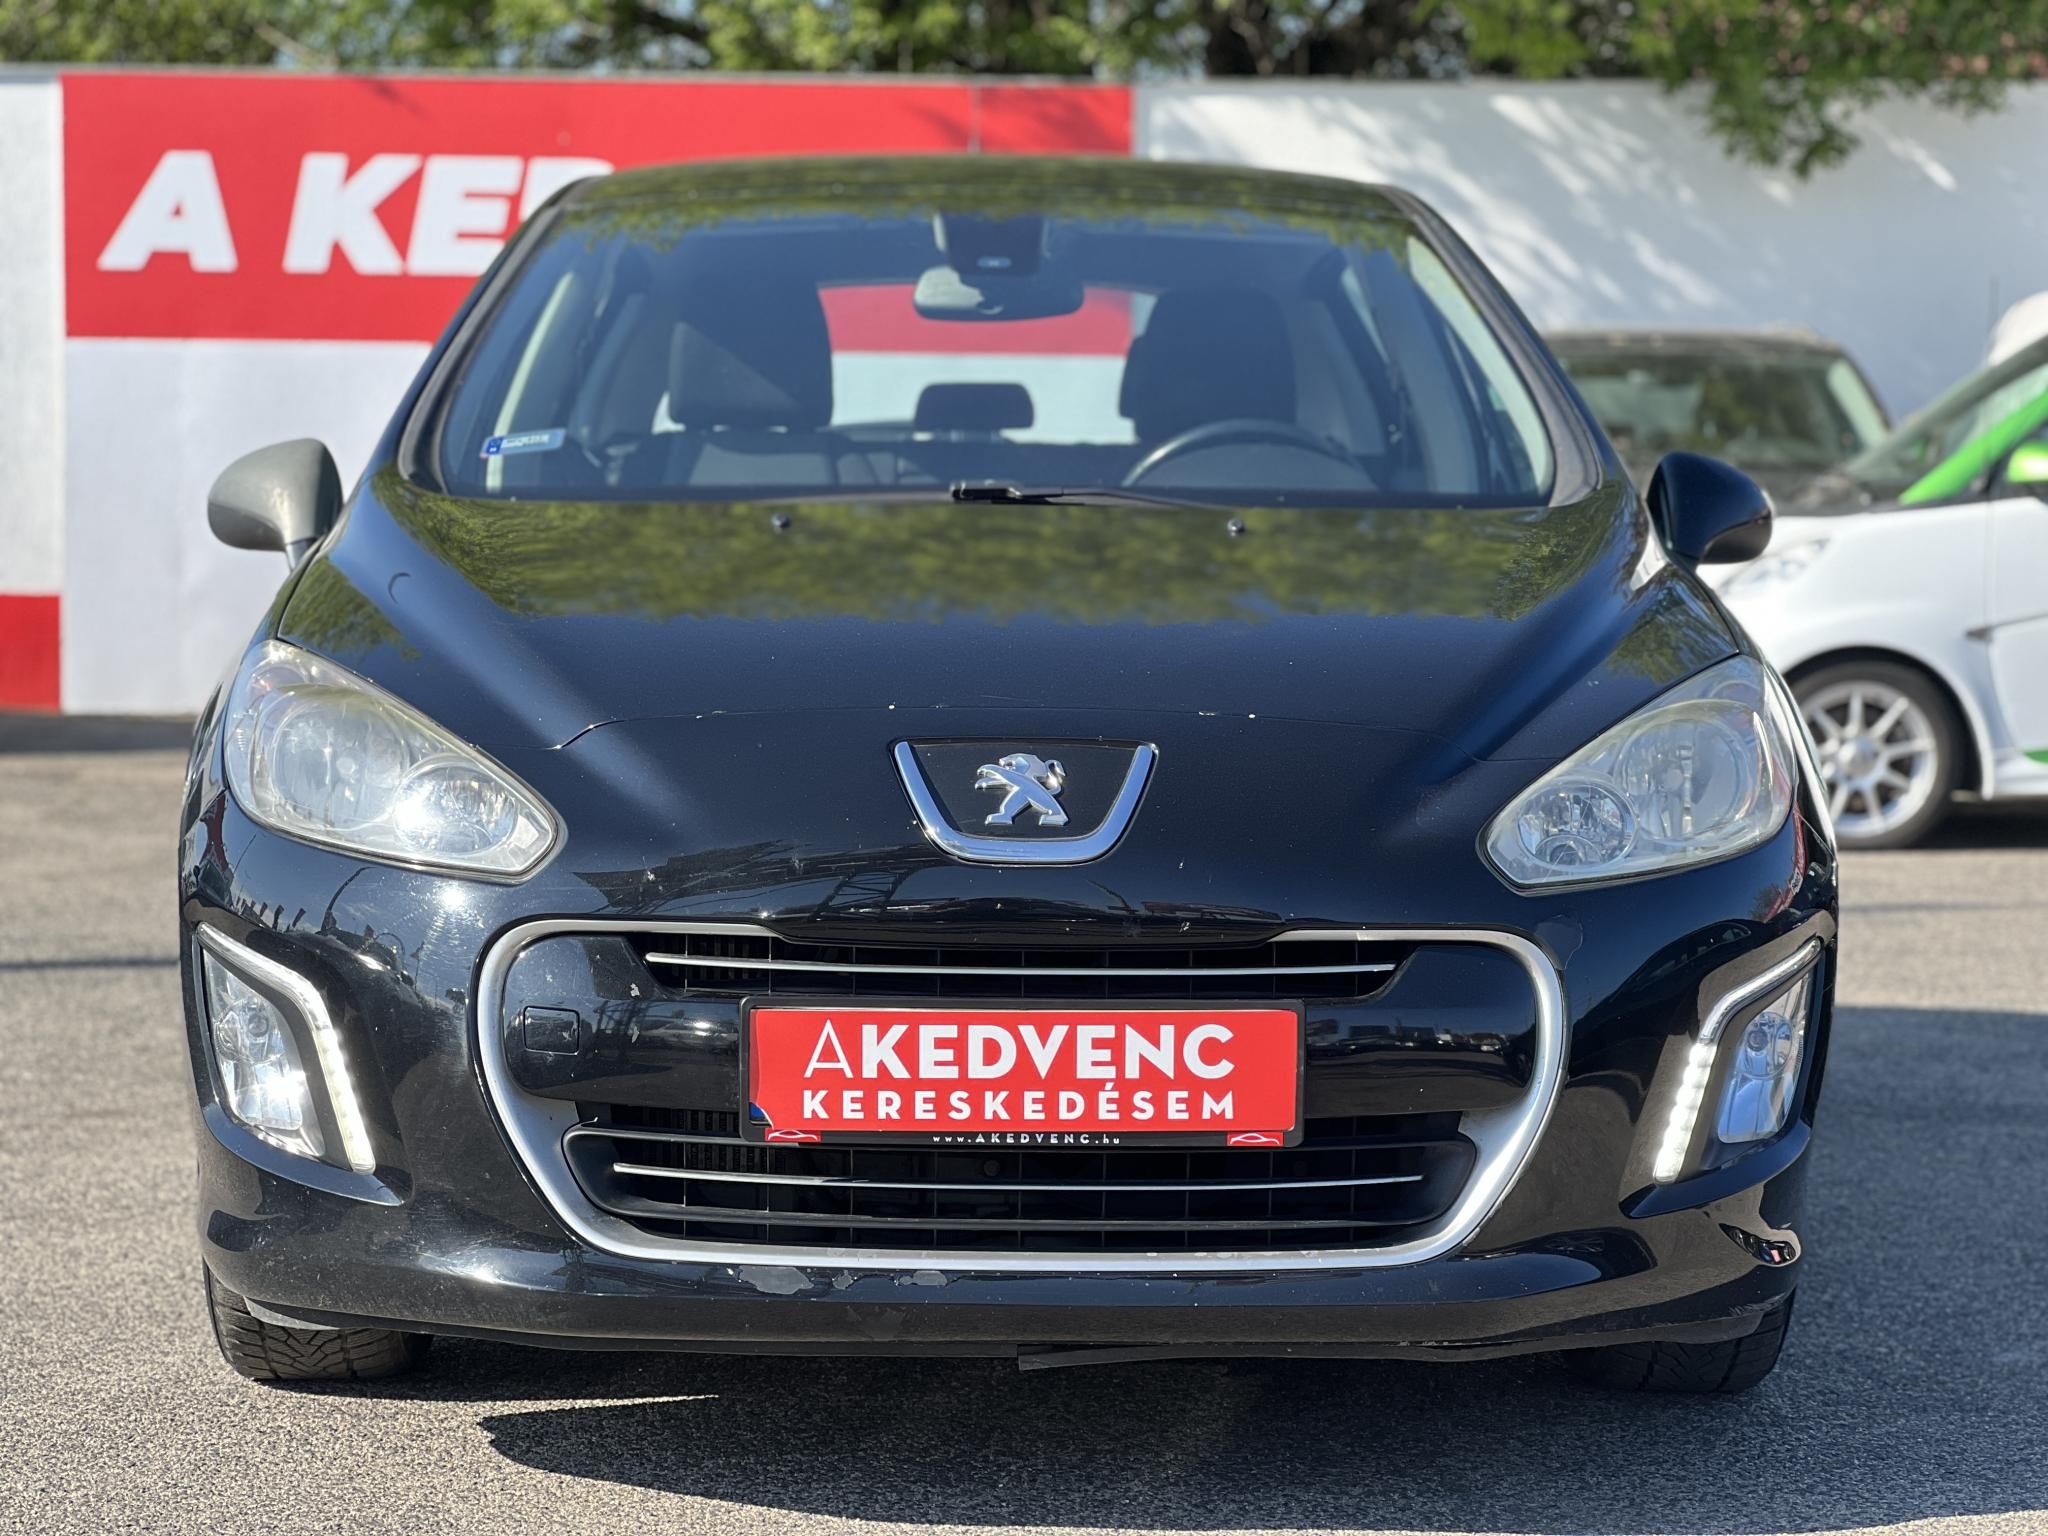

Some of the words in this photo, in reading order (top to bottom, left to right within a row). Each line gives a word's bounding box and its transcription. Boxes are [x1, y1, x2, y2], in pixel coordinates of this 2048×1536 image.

[97, 150, 238, 273] A
[803, 1082, 1235, 1121] KERESKEDÉSEM
[932, 1133, 1120, 1145] www.AKEDVENC.hu
